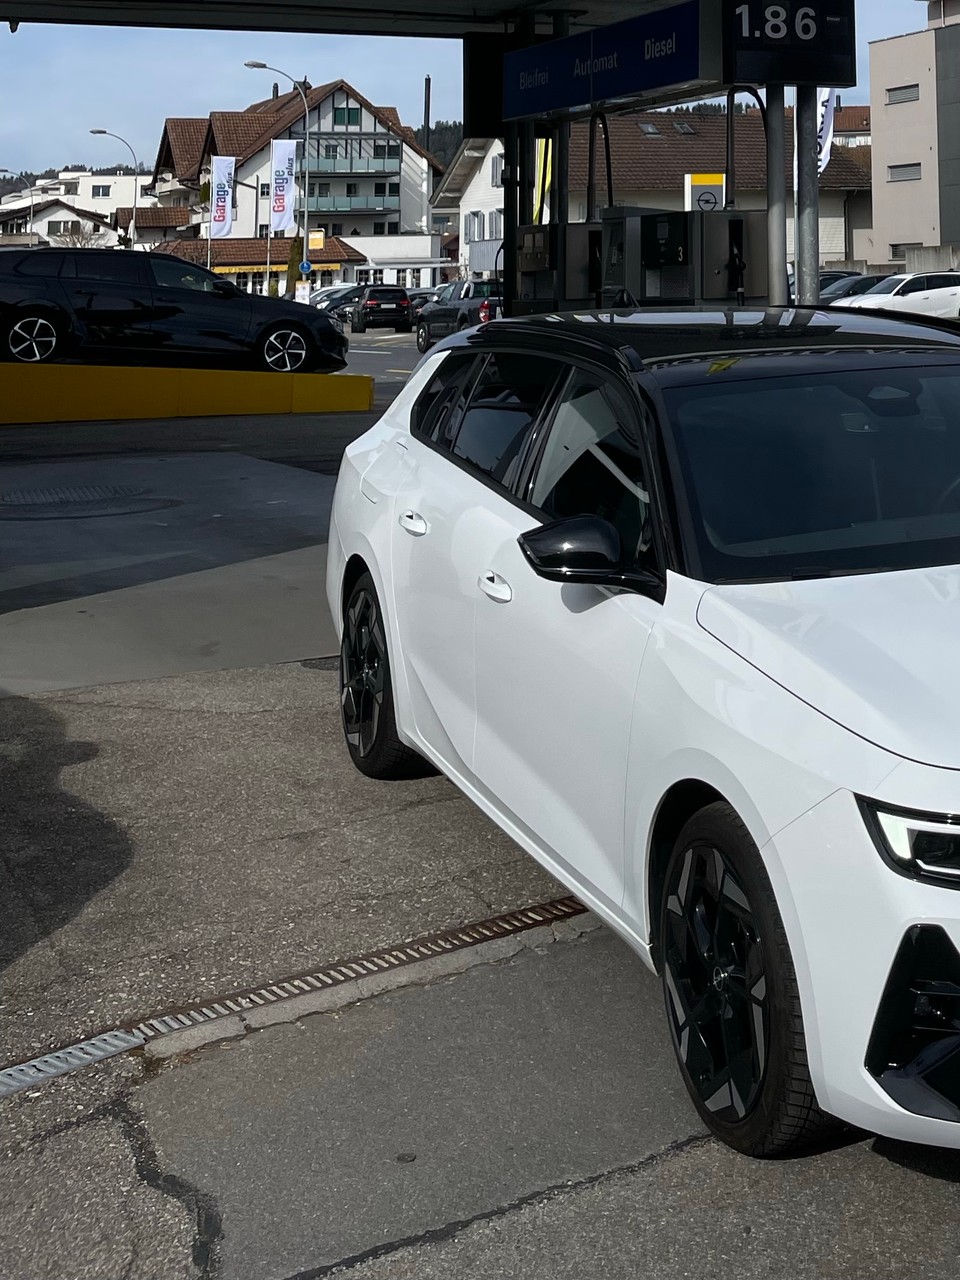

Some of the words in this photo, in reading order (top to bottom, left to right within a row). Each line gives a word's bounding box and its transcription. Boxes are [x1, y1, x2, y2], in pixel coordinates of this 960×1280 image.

[735, 4, 817, 40] 1.86
[519, 67, 549, 90] Bleifrei
[573, 51, 618, 78] Automat
[644, 32, 676, 61] Diesel
[286, 157, 294, 177] plus
[213, 182, 229, 223] Garage
[272, 169, 288, 213] Garage
[677, 246, 683, 262] 3
